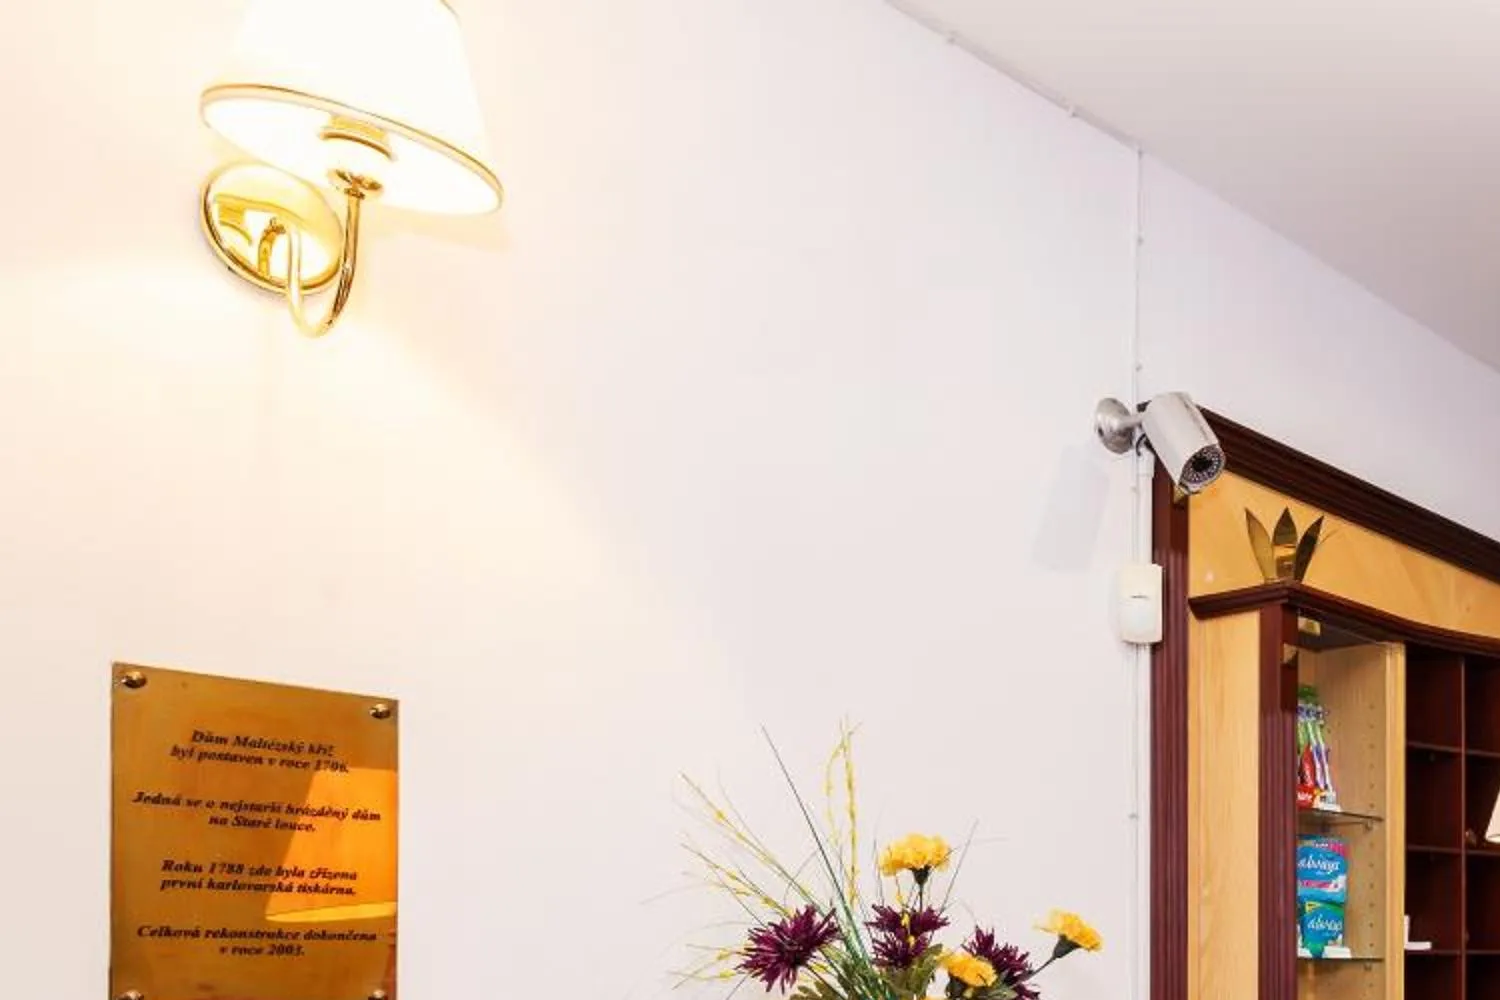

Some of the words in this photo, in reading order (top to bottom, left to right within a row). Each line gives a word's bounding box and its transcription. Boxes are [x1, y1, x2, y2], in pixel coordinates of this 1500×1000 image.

[170, 744, 195, 761] byl
[197, 749, 264, 767] postaven
[279, 758, 311, 771] roce
[161, 859, 203, 874] Roku
[275, 865, 305, 880] byla
